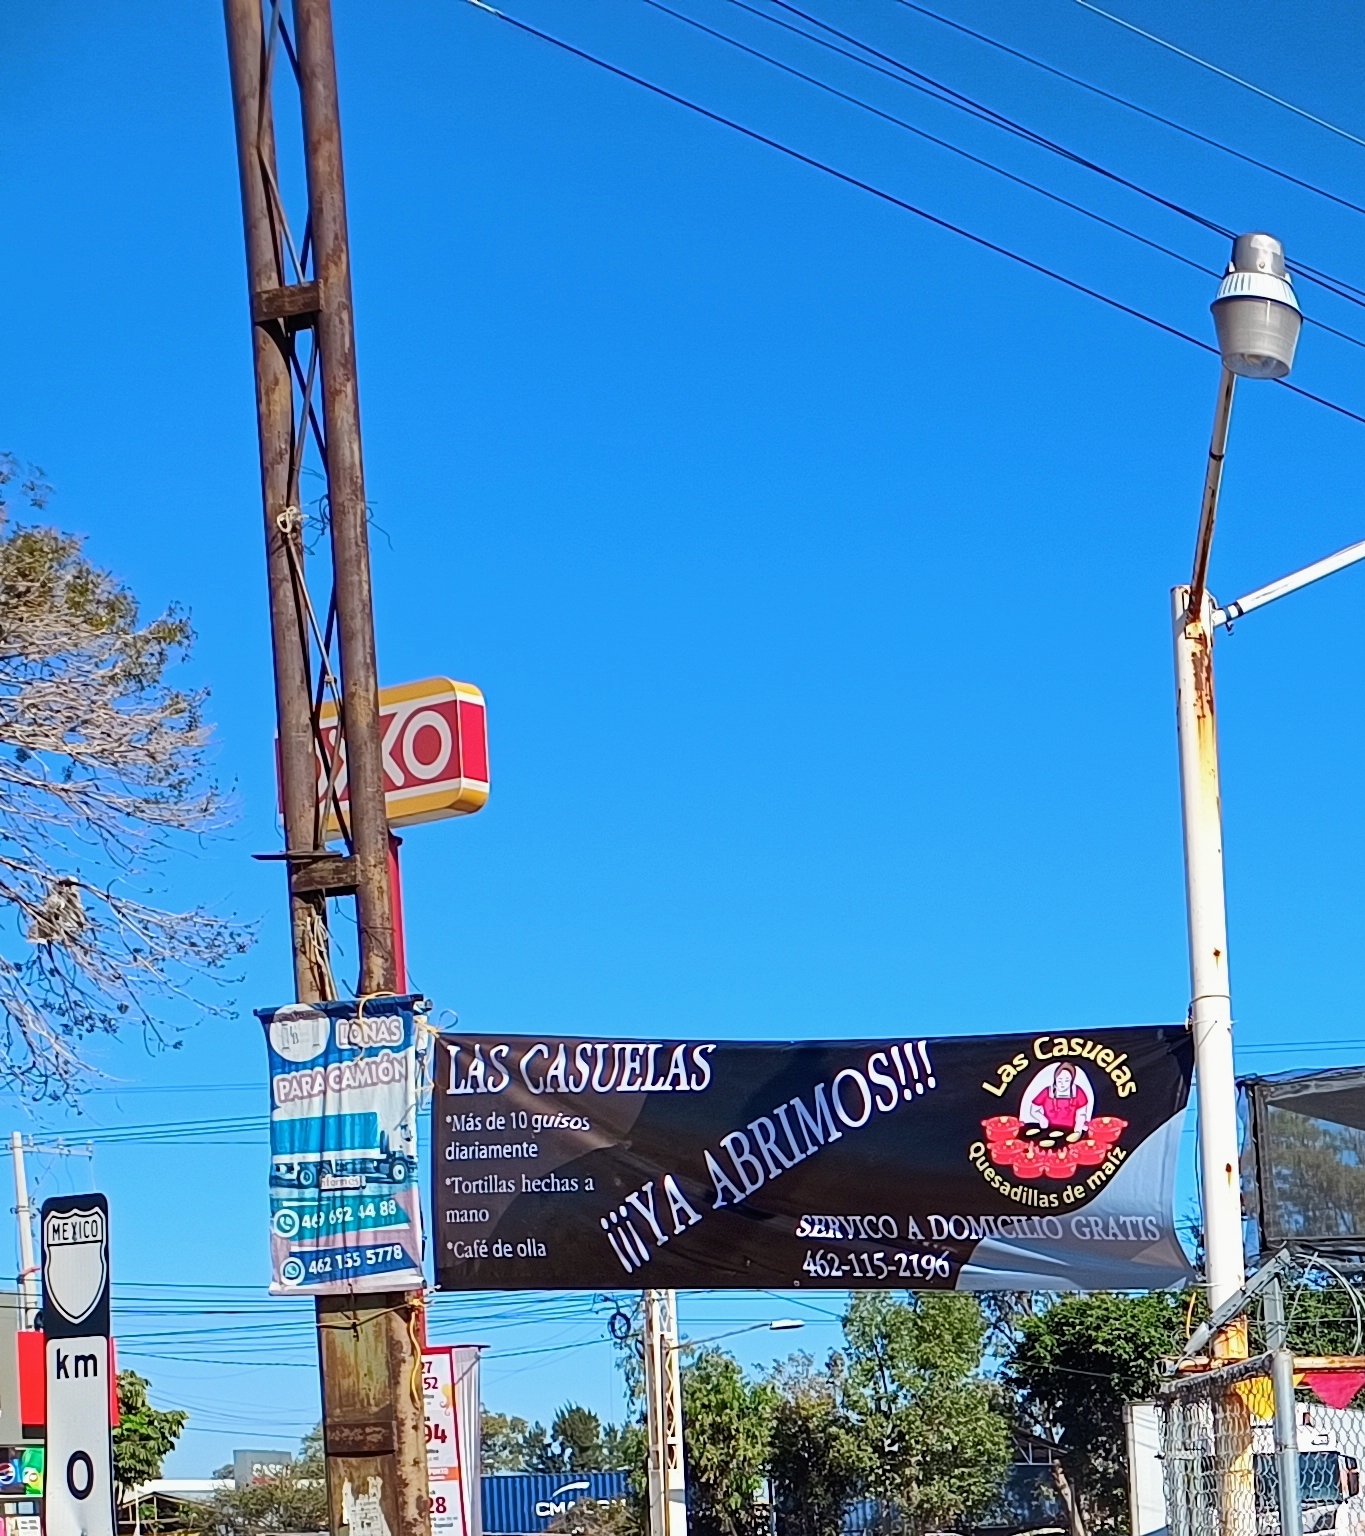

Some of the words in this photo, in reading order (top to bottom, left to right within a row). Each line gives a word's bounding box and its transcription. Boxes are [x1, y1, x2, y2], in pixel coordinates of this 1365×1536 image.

[338, 1018, 403, 1046] LONAS
[278, 1072, 325, 1101] PARA
[328, 1052, 407, 1091] CAMIÓN
[446, 1044, 511, 1095] LAS
[519, 1043, 717, 1095] CASUELAS
[982, 1049, 1029, 1097] Las
[1033, 1036, 1137, 1099] Casuelas
[486, 1111, 506, 1131] de
[510, 1111, 528, 1130] 10
[532, 1112, 590, 1133] guisos
[703, 1040, 937, 1210] ABRIMOS!!!
[445, 1141, 538, 1161] diariamente
[320, 1176, 360, 1188] nformes
[521, 1173, 578, 1193] hechas
[584, 1178, 595, 1192] a
[968, 1140, 1060, 1208] Quesadillas
[1062, 1184, 1086, 1204] de
[1087, 1145, 1127, 1189] maíz
[328, 1206, 354, 1225] 692
[379, 1199, 397, 1216] 88
[445, 1208, 490, 1223] mano
[52, 1219, 99, 1242] MEXICO
[795, 1214, 899, 1240] SERVICO
[907, 1215, 925, 1241] A
[927, 1214, 1063, 1241] DOMICILIO
[1070, 1215, 1162, 1241] GRATIS
[308, 1257, 333, 1275] 462
[365, 1244, 403, 1265] 5778
[492, 1238, 514, 1258] de
[516, 1238, 547, 1258] olla
[801, 1249, 950, 1280] 462-115-2196
[56, 1348, 98, 1380] km
[67, 1450, 94, 1500] 0
